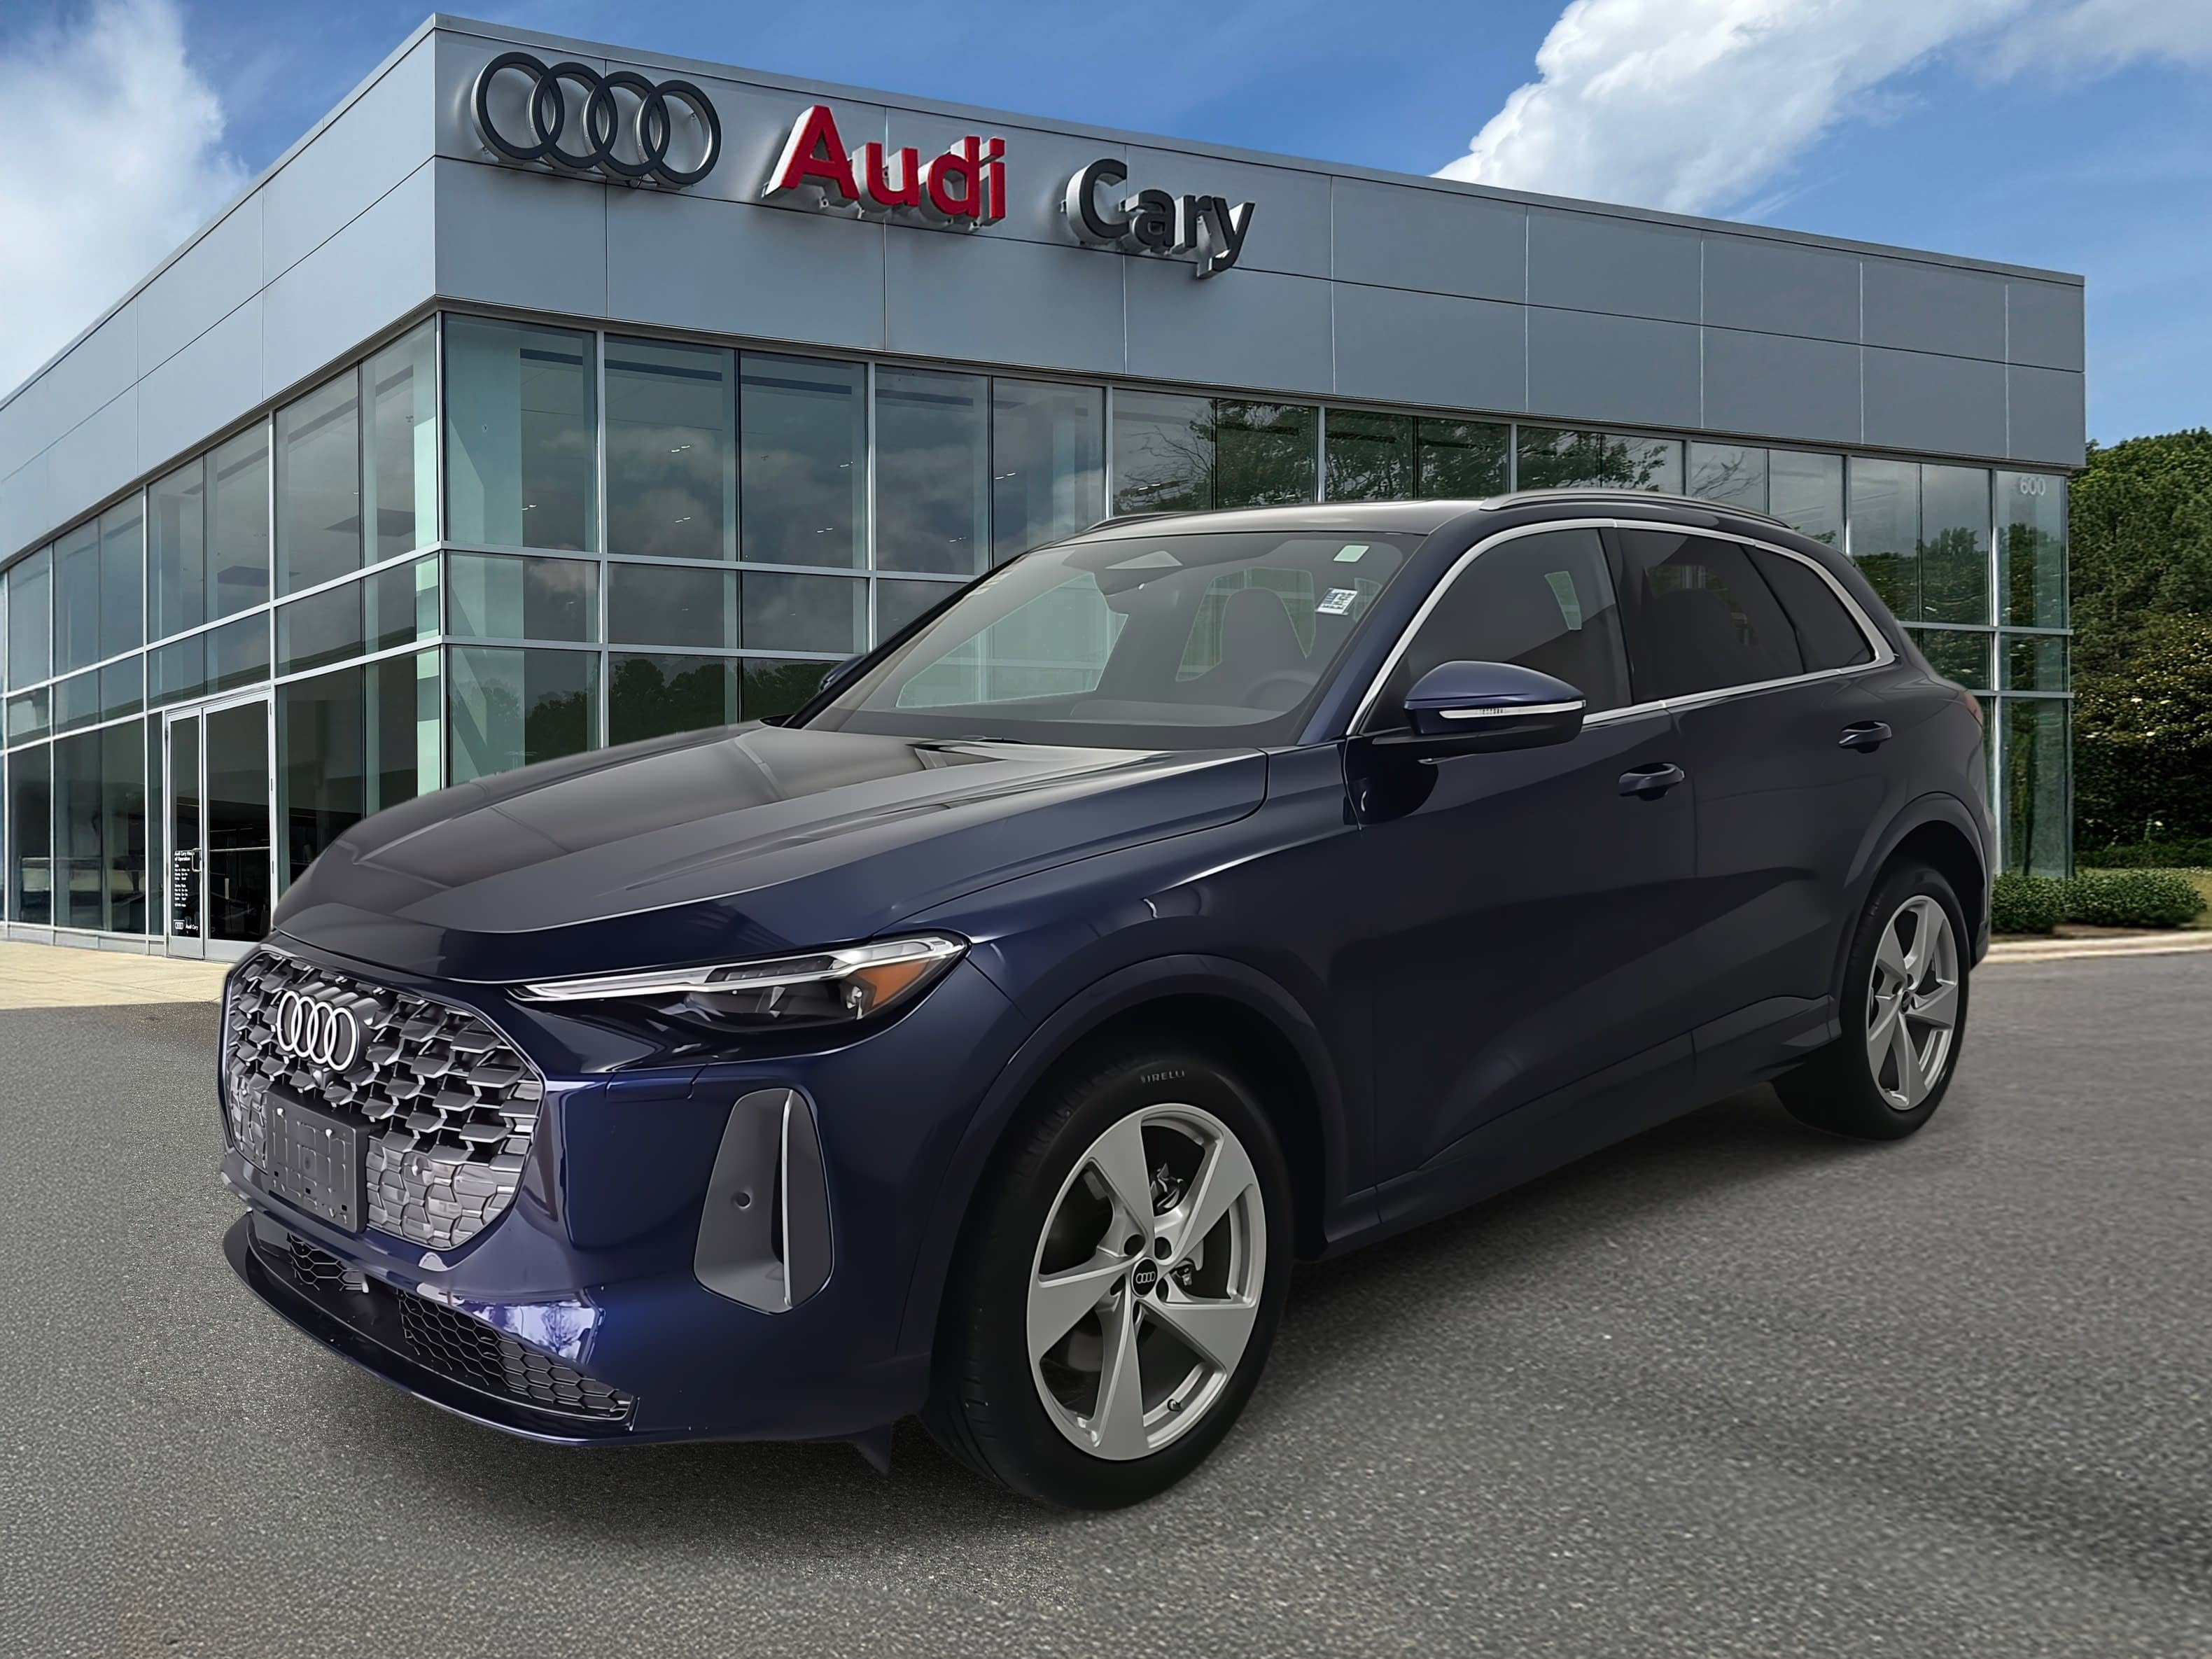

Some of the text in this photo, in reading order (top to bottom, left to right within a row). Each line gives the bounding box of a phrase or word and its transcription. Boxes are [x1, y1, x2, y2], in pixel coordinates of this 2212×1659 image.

[766, 104, 1256, 279] Audi Cary
[2019, 476, 2046, 496] 600
